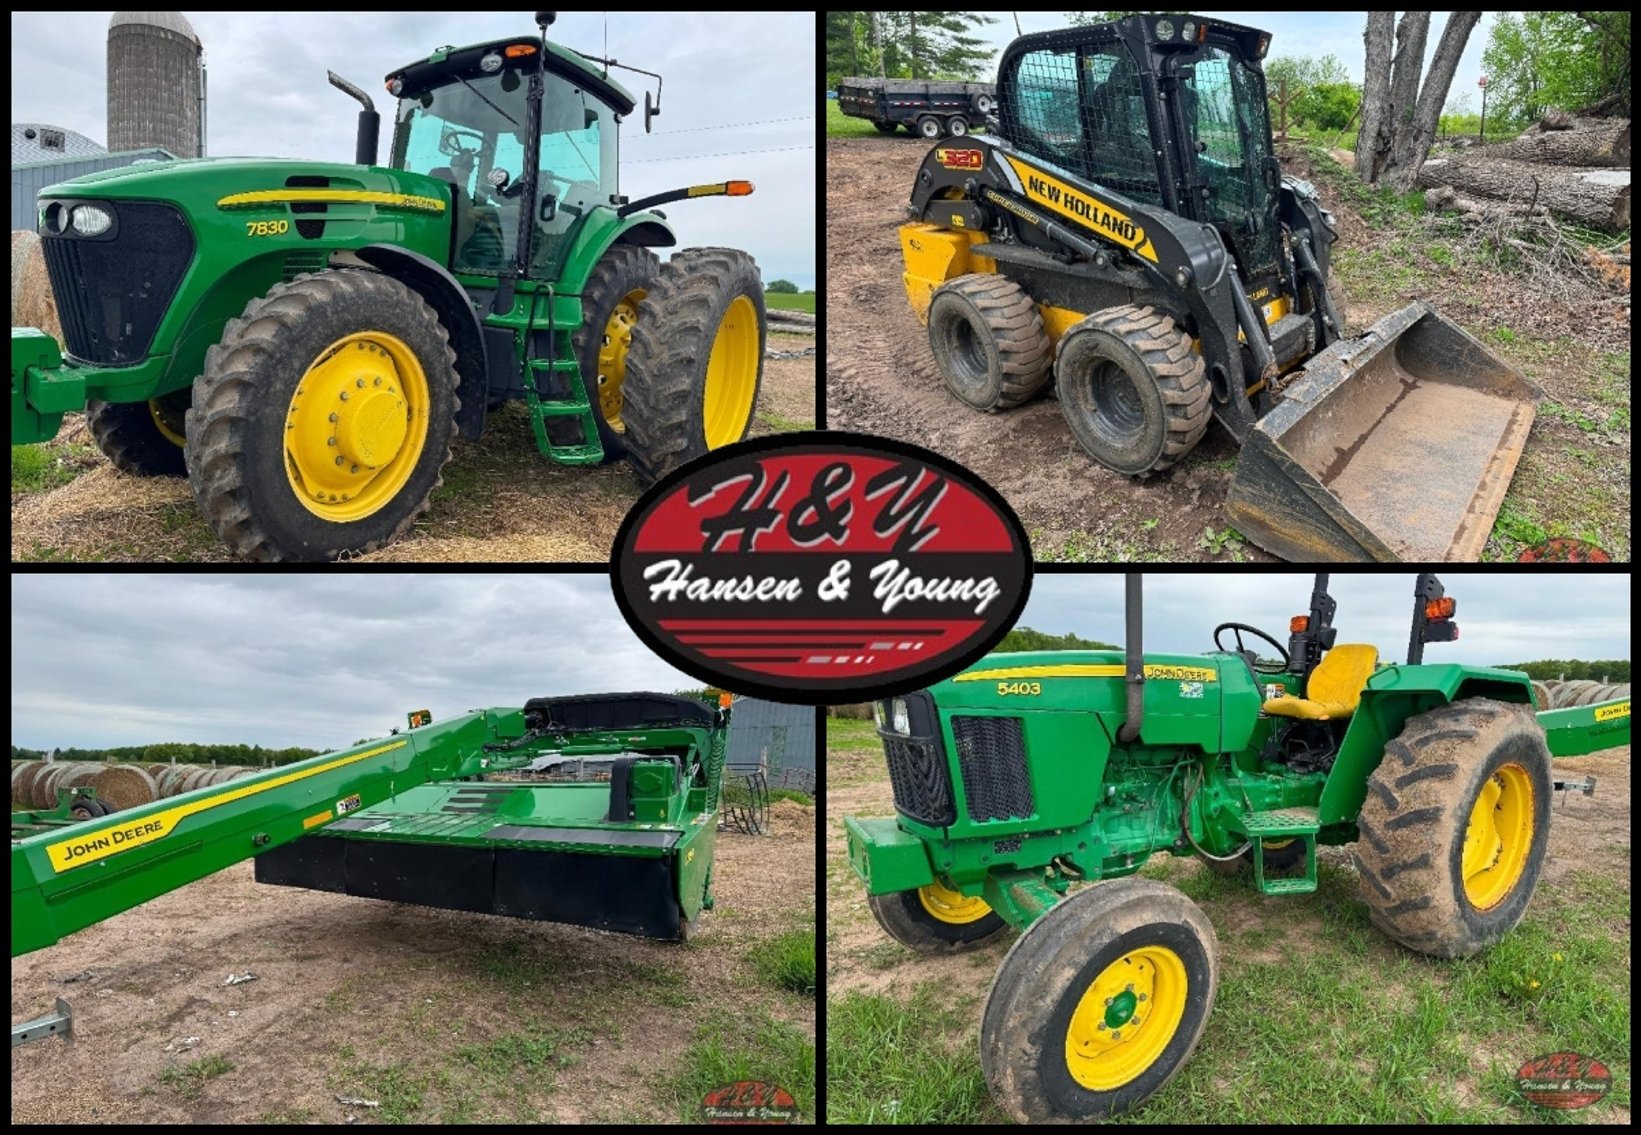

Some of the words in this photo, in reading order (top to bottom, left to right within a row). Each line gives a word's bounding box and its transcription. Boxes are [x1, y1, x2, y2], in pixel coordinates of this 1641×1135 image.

[1028, 175, 1061, 204] NEW
[1063, 193, 1136, 242] HOLLAND
[246, 219, 289, 237] 7830
[1148, 666, 1176, 680] JOHN
[1176, 667, 1209, 682] DEERE
[997, 682, 1041, 696] 5403
[64, 837, 110, 861] JOHN
[112, 820, 163, 844] DEERE
